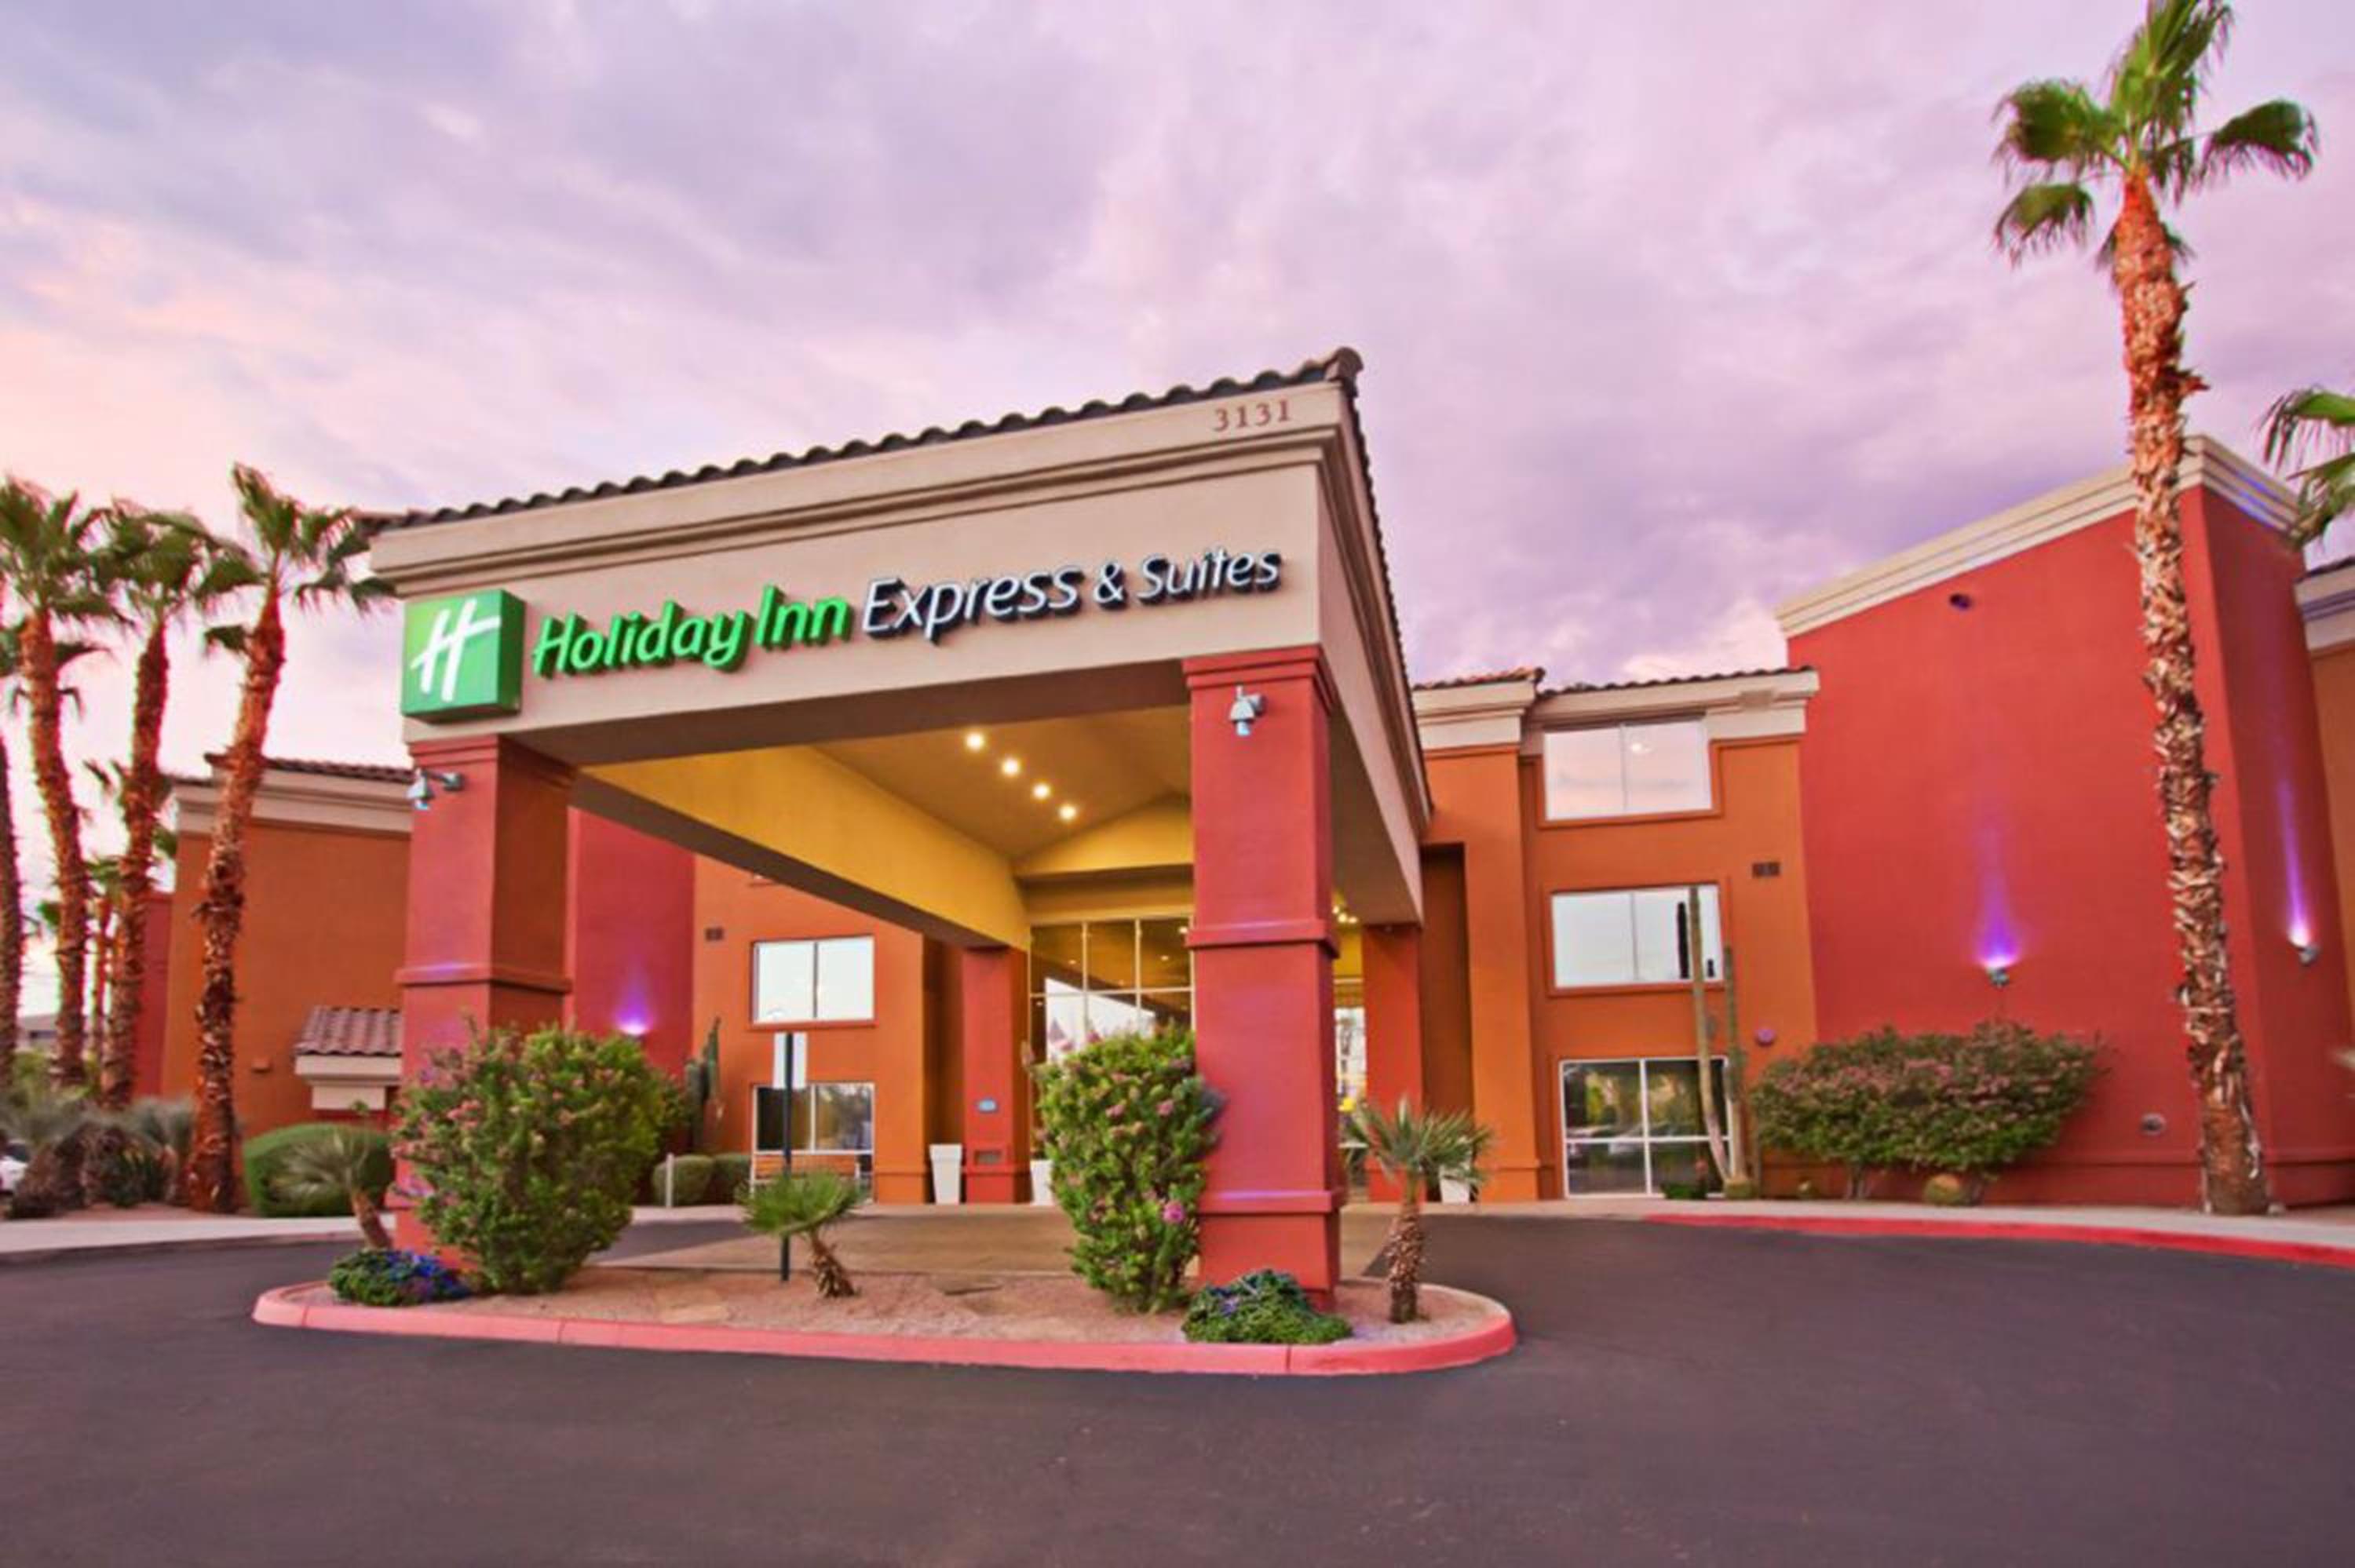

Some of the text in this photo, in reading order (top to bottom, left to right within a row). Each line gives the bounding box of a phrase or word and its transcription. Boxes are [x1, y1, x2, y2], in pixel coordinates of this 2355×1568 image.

[1214, 398, 1290, 432] 3131
[531, 549, 1283, 672] Holiday Inn Express & Suites
